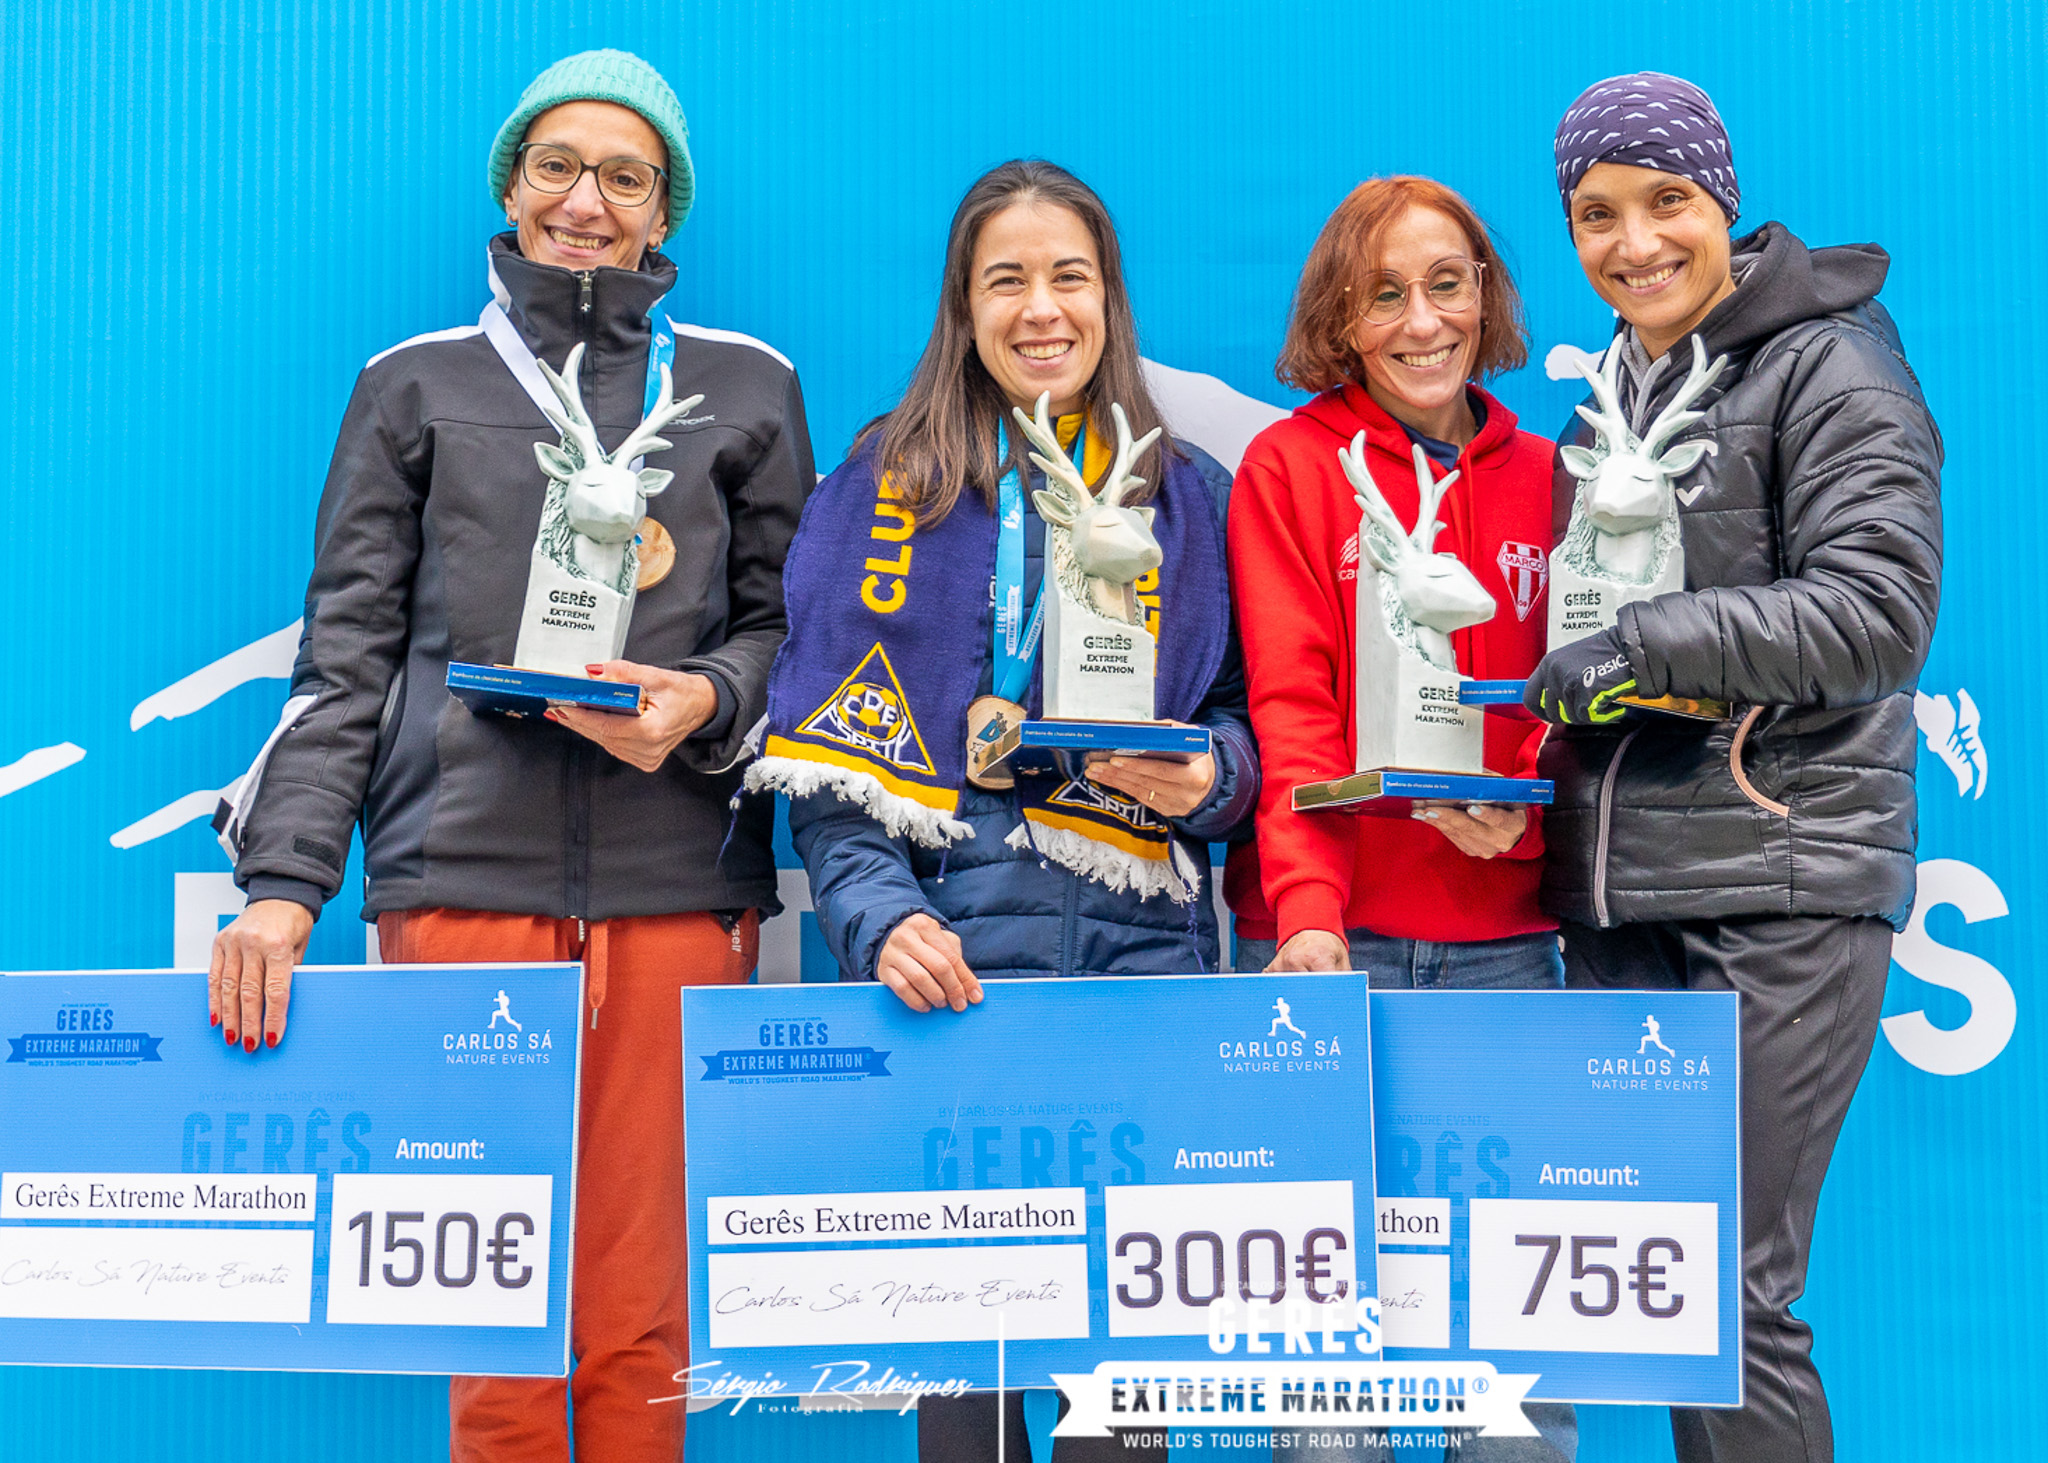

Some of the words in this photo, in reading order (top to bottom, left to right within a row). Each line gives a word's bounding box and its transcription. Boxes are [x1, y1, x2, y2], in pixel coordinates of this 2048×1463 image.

[1504, 554, 1544, 572] MARCO
[549, 590, 597, 608] GERÊS
[1564, 589, 1602, 607] GERÊS
[541, 617, 595, 631] MARATHON
[550, 608, 591, 620] EXTREME
[1566, 610, 1598, 619] EXTREME
[1561, 621, 1603, 630] MARATHON
[1083, 634, 1132, 651] GERÊS
[1080, 664, 1135, 674] MARATHON
[1087, 654, 1128, 663] EXTREME
[1597, 653, 1630, 677] asic
[1415, 714, 1465, 726] MARATHON
[1422, 705, 1459, 715] EXTREME
[56, 1008, 114, 1031] GERÊS
[443, 1033, 518, 1050] CARLOS
[528, 1029, 552, 1050] SÁ
[760, 1022, 829, 1047] GERÊS
[26, 1039, 75, 1053] EXTREME
[1219, 1040, 1303, 1058] CARLOS
[1314, 1035, 1341, 1056] SÁ
[446, 1054, 496, 1065] NATURE
[502, 1053, 550, 1065] EVENTS
[723, 1056, 784, 1071] EXTREME
[1224, 1061, 1280, 1072] NATURE
[1286, 1060, 1340, 1072] EVENTS
[1587, 1058, 1671, 1076] CARLOS
[1683, 1056, 1710, 1076] SÁ
[1592, 1079, 1648, 1090] NATURE
[1655, 1080, 1708, 1091] EVENTS
[182, 1107, 371, 1183] GERÊS
[395, 1138, 484, 1159] Amount:
[923, 1119, 1146, 1191] GERÊS
[1174, 1147, 1275, 1169] Amount:
[1387, 1131, 1510, 1199] RÊS
[1539, 1163, 1639, 1186] Amount:
[15, 1183, 80, 1208] Gerês
[88, 1183, 185, 1208] Extreme
[193, 1184, 307, 1209] Marathon
[725, 1209, 804, 1236] Gerês
[814, 1207, 932, 1234] Extreme
[941, 1203, 1076, 1230] Marathon
[1377, 1208, 1440, 1234] thon
[349, 1211, 535, 1289] 150€
[2, 1259, 72, 1286] Carlos
[78, 1259, 122, 1287] Sá
[131, 1259, 209, 1295] Nature
[216, 1261, 291, 1288] Events
[1115, 1227, 1347, 1308] 300€
[1515, 1234, 1684, 1318] 75€
[715, 1285, 799, 1314] Carlos
[809, 1283, 864, 1312] Sá
[872, 1281, 970, 1317] Nature
[975, 1278, 1064, 1308] Events
